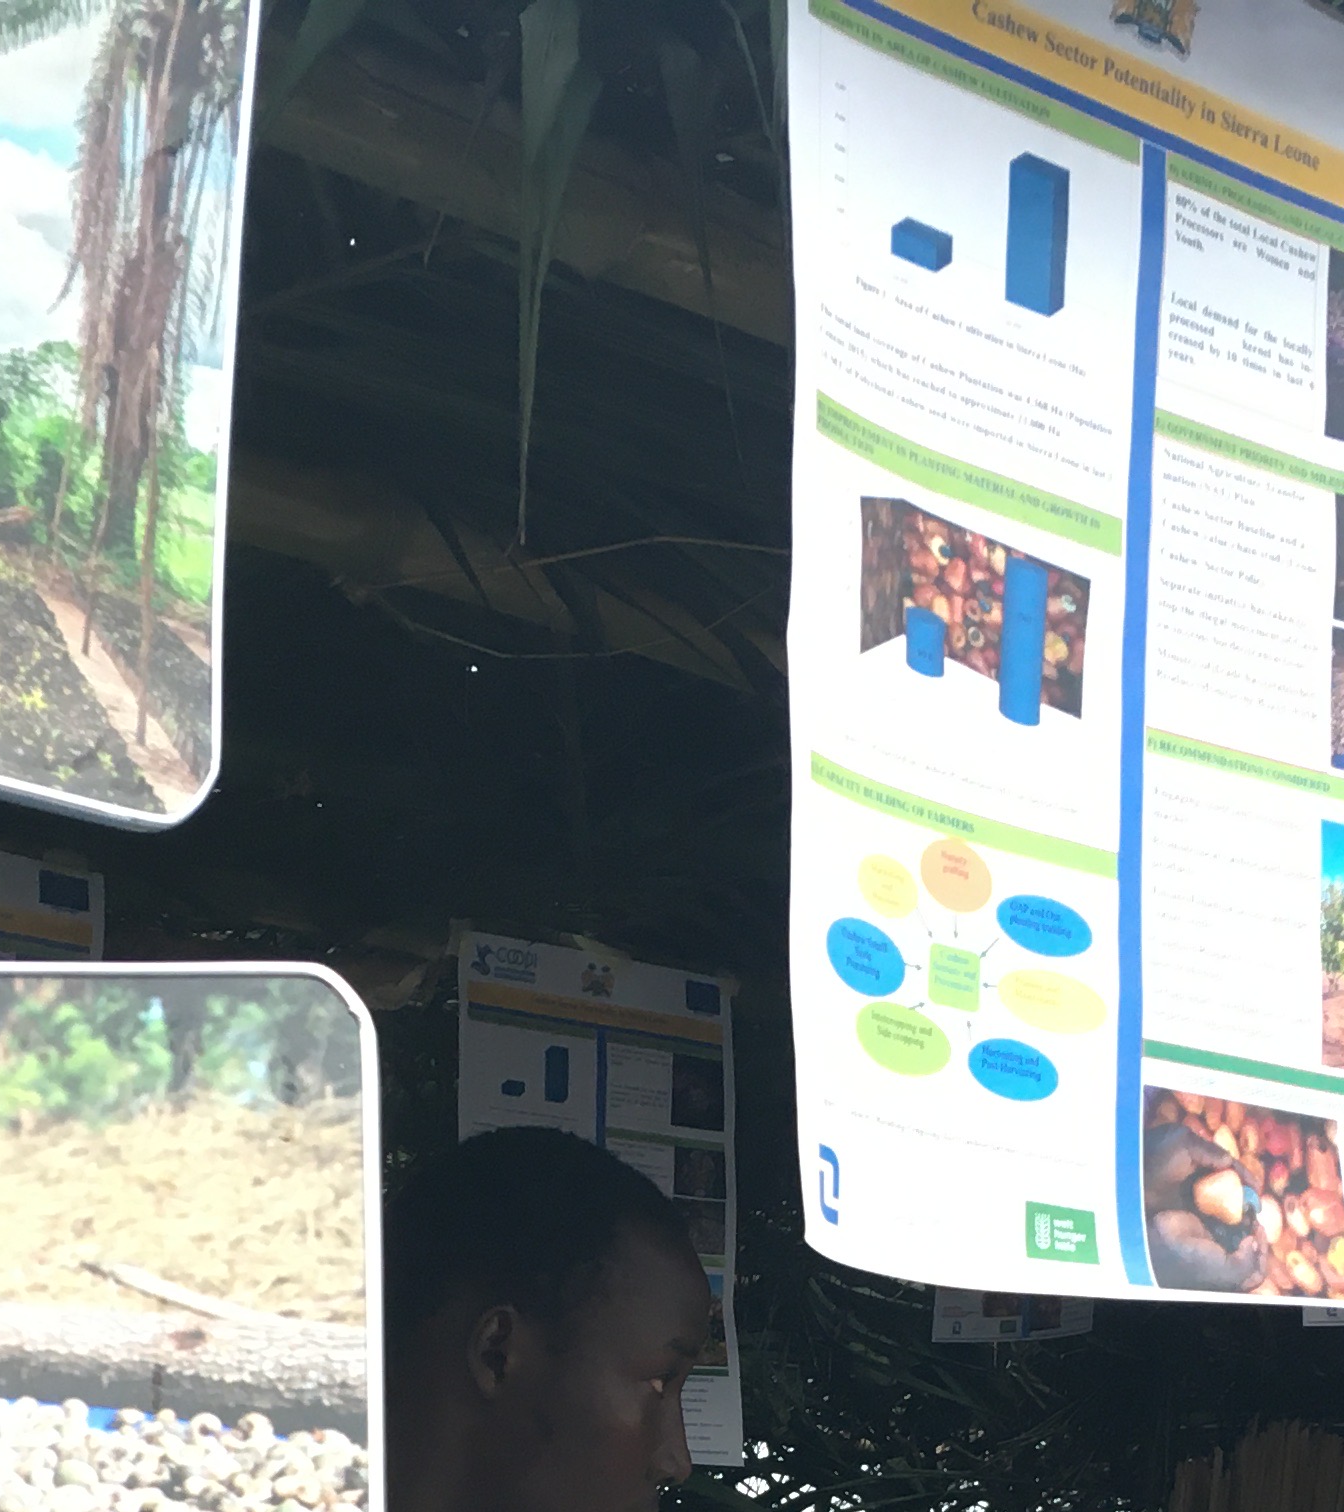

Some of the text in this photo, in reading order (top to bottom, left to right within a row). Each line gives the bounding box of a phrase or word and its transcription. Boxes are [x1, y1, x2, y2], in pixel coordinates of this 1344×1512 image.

[971, 0, 1320, 171] Cashew Sector Potentiality in Sierra Leone
[1200, 203, 1317, 264] of the total Local Cashew
[1169, 311, 1215, 338] processed
[1170, 290, 1197, 312] Local
[1201, 303, 1239, 331] demand
[1244, 321, 1258, 337] for
[1263, 326, 1278, 344] the
